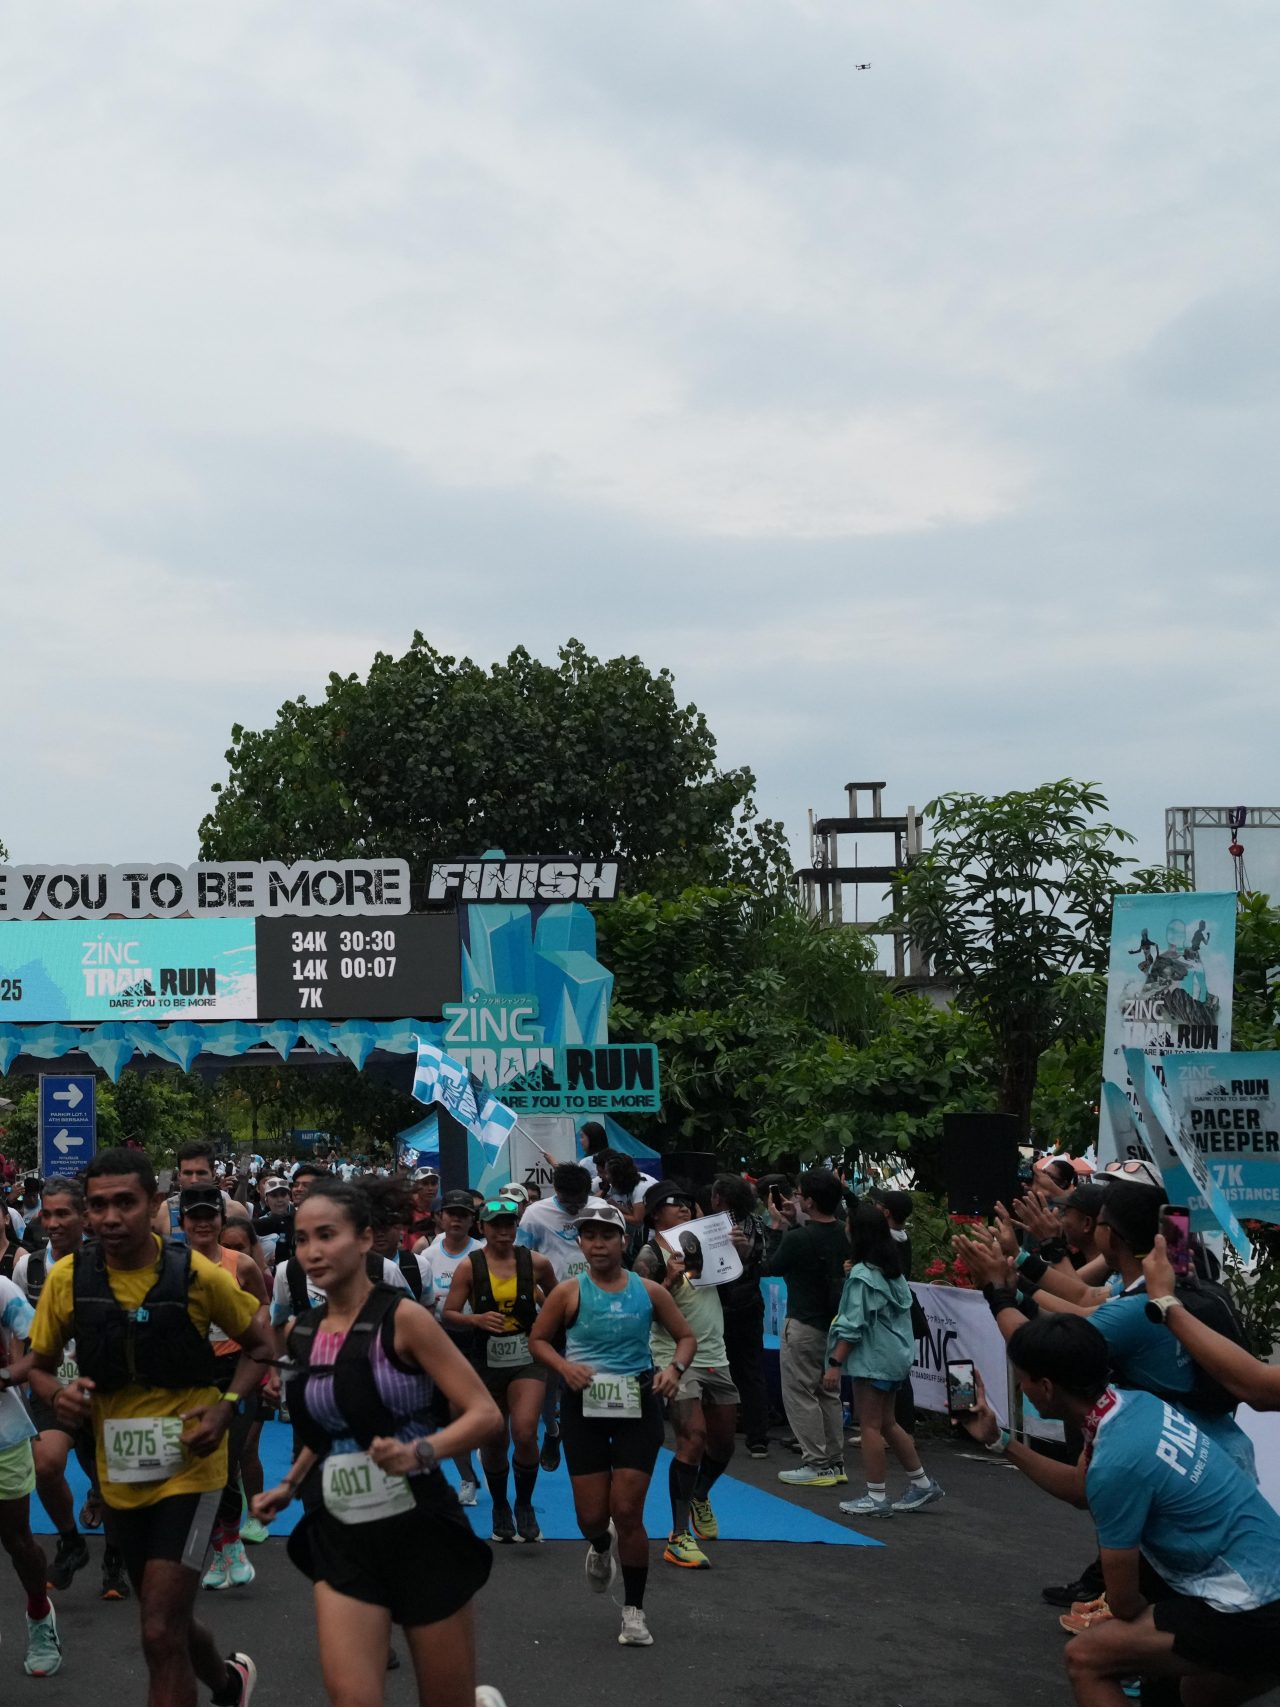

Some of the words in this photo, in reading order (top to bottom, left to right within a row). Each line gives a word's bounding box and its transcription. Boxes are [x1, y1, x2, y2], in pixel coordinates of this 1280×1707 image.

[23, 873, 107, 910] YOU
[122, 872, 184, 909] TO
[197, 871, 255, 908] BE
[268, 869, 402, 907] MORE
[428, 863, 618, 899] FINISH
[291, 931, 328, 952] 34K
[340, 930, 396, 951] 30:30
[81, 941, 140, 965] ZINC
[292, 959, 328, 980] 14K
[340, 957, 397, 979] 00:07
[83, 968, 156, 996] TRAIL
[160, 968, 216, 996] RUN
[109, 1000, 134, 1008] DARE
[137, 999, 155, 1007] YOU
[159, 999, 170, 1007] TO
[173, 999, 186, 1007] BE
[188, 999, 216, 1007] MORE
[298, 988, 323, 1009] 7K
[1123, 999, 1165, 1021] ZINC
[445, 1007, 534, 1042] ZINC
[1177, 1024, 1219, 1050] RUN
[1143, 1048, 1157, 1056] ARE
[447, 1047, 561, 1092] TRAIL
[566, 1048, 653, 1091] RUN
[1178, 1065, 1217, 1080] ZINC
[1231, 1079, 1269, 1095] RUN
[531, 1095, 560, 1108] YOU
[563, 1095, 585, 1107] TO
[588, 1095, 608, 1107] BE
[612, 1095, 655, 1107] MORE
[1190, 1108, 1261, 1131] PACER
[524, 1168, 553, 1185] ZIN
[1212, 1164, 1245, 1188] 7K
[490, 1341, 518, 1356] 4327
[58, 1361, 80, 1379] 304
[588, 1382, 621, 1401] 4071
[112, 1429, 157, 1457] 4275
[330, 1463, 372, 1498] 4017
